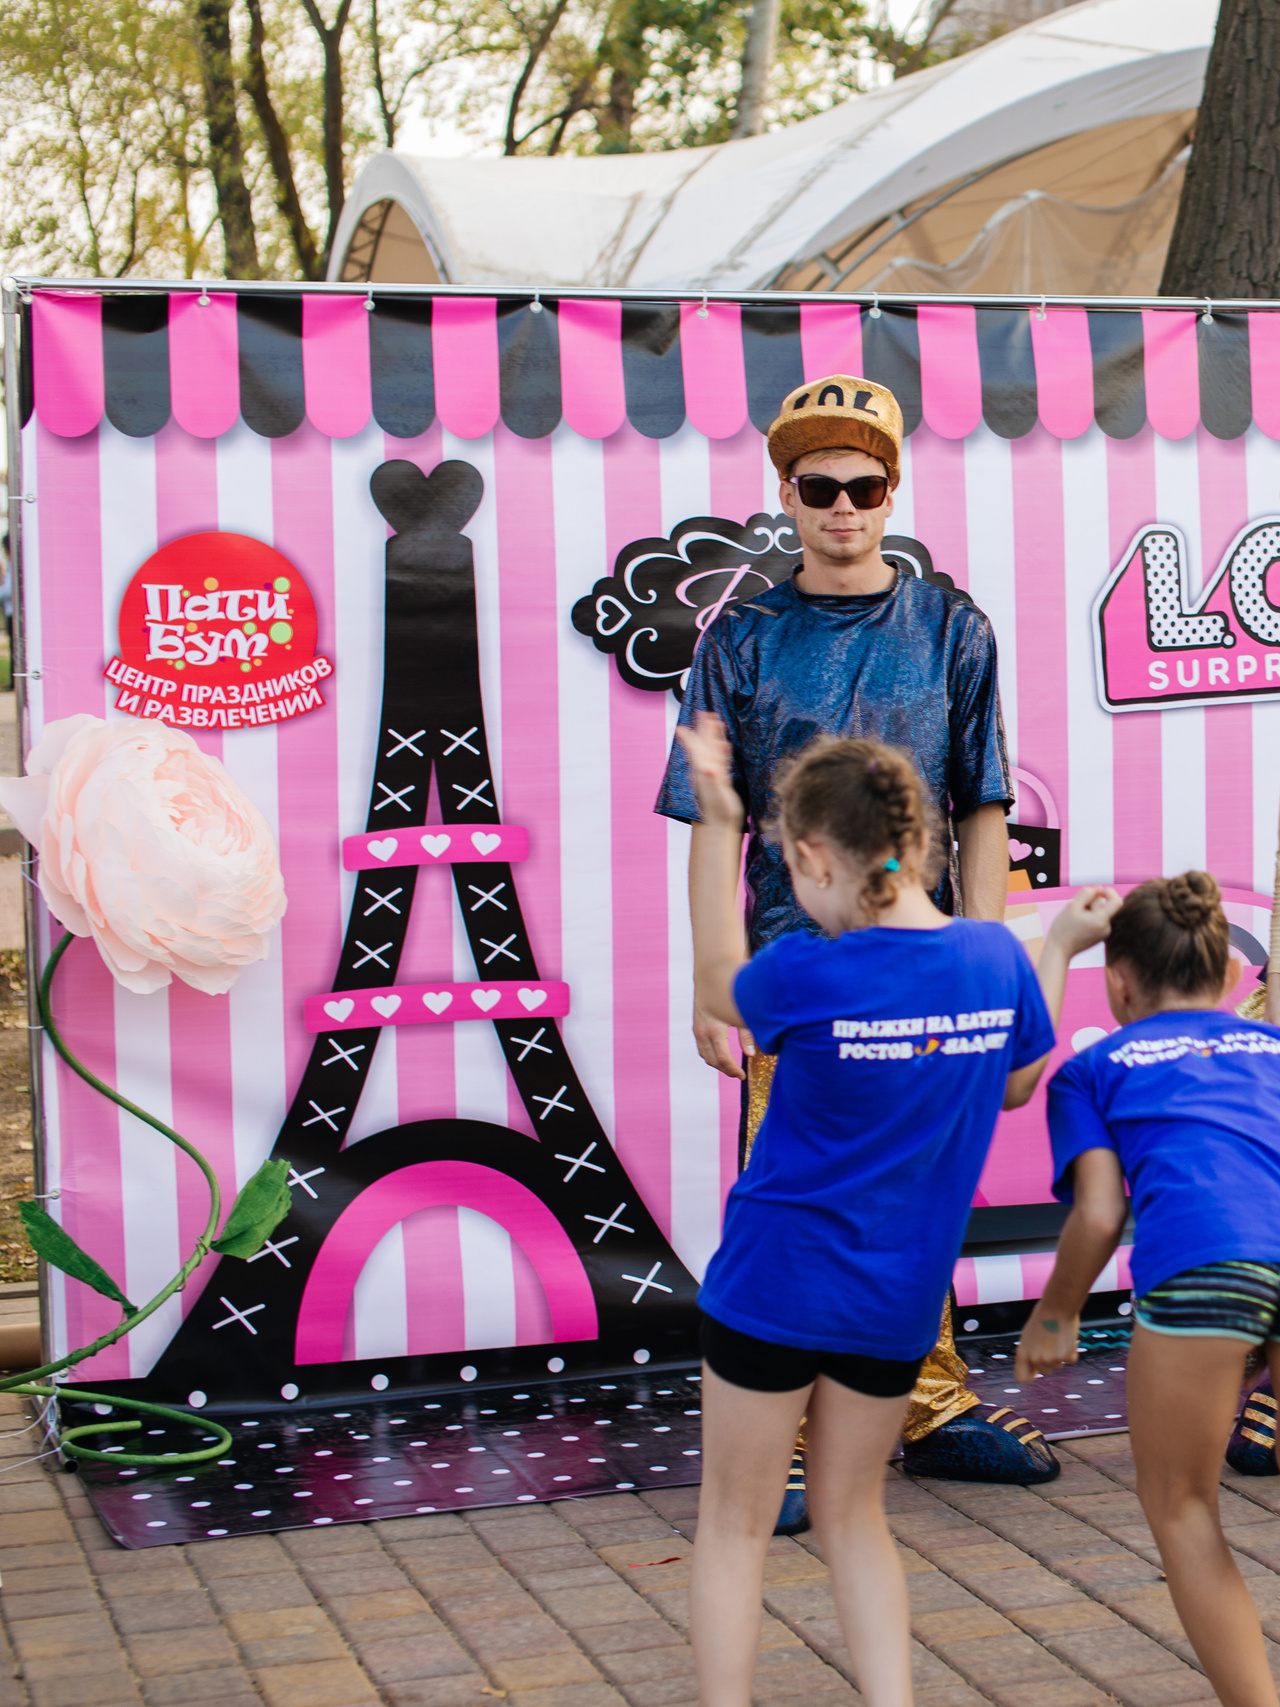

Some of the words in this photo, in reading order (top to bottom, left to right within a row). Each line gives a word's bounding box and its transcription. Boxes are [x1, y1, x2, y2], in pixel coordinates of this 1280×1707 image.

[142, 584, 292, 621] Пати
[145, 622, 270, 666] Бум
[105, 659, 178, 698] ЦЕНТР
[181, 657, 333, 705] ПРАЗДНИКОВ
[117, 690, 140, 712] И
[143, 685, 323, 727] РАЗВЛЕЧЕНИЙ
[925, 1014, 955, 1034] НА
[838, 1041, 914, 1060] РОСТОВ
